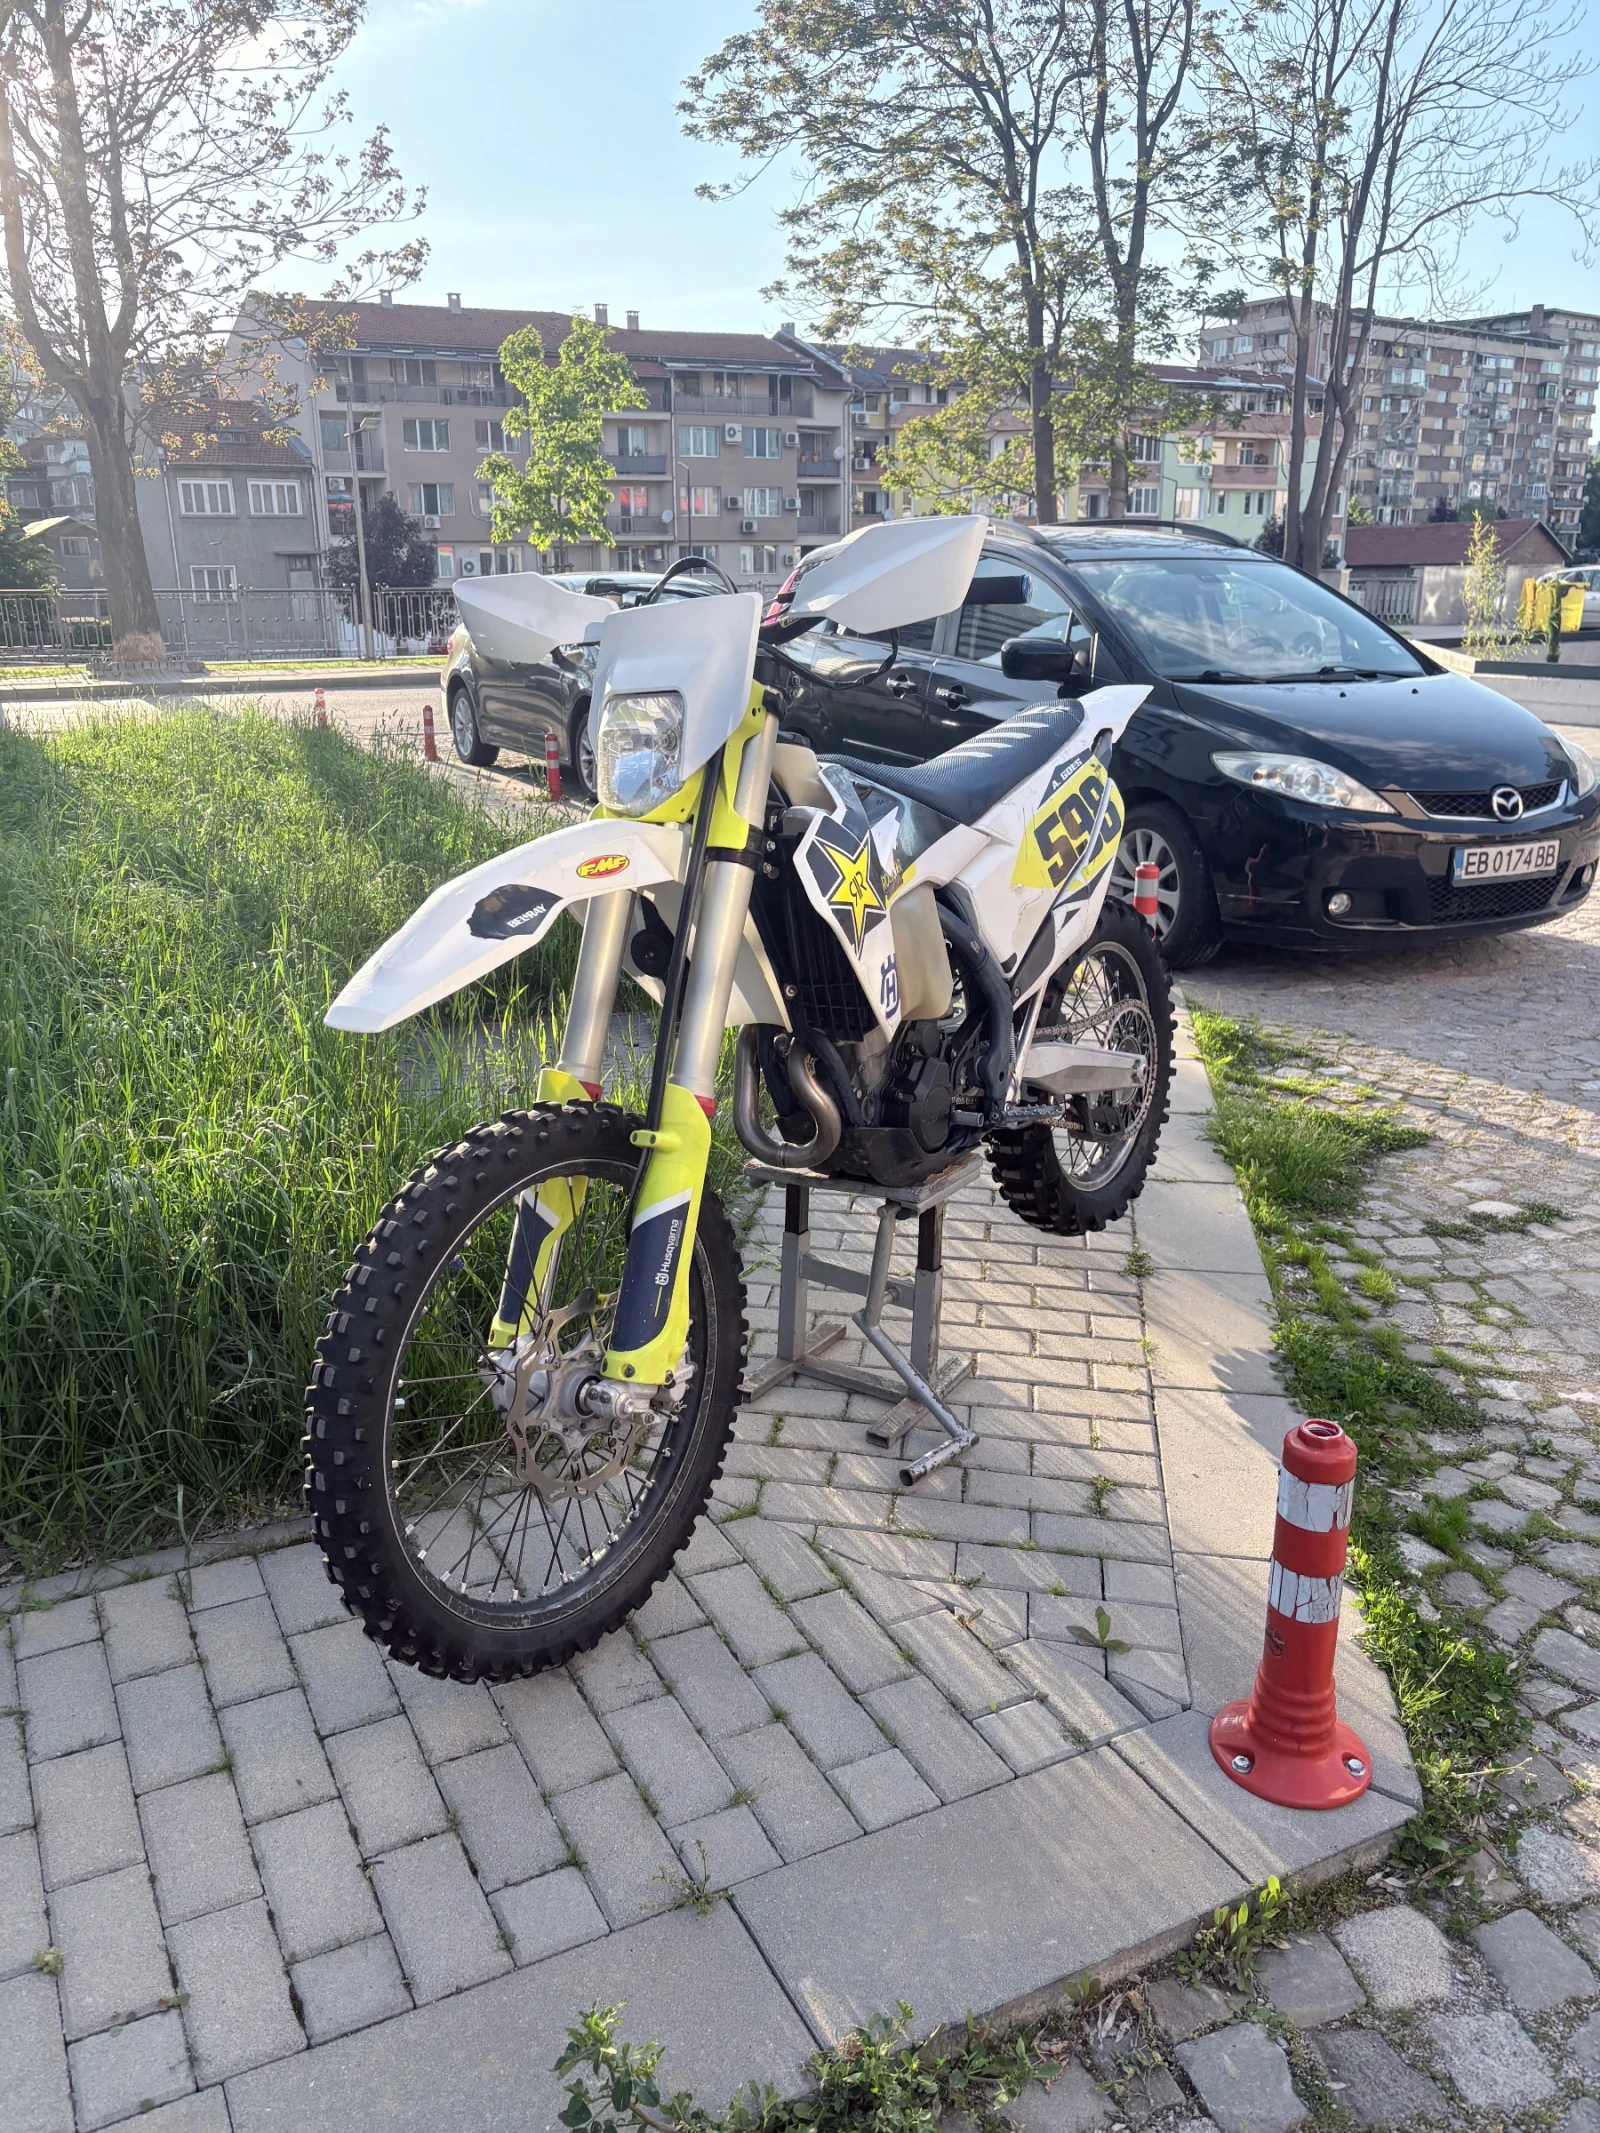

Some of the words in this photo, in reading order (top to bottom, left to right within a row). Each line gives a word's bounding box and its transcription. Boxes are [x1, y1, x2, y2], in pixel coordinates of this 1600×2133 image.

[1061, 758, 1083, 780] GOES
[1034, 775, 1121, 888] 598
[578, 856, 628, 877] FMF
[1464, 851, 1489, 876] EB
[1492, 847, 1534, 873] 0174
[1534, 844, 1556, 868] BB
[660, 1218, 679, 1273] Husqvarna
